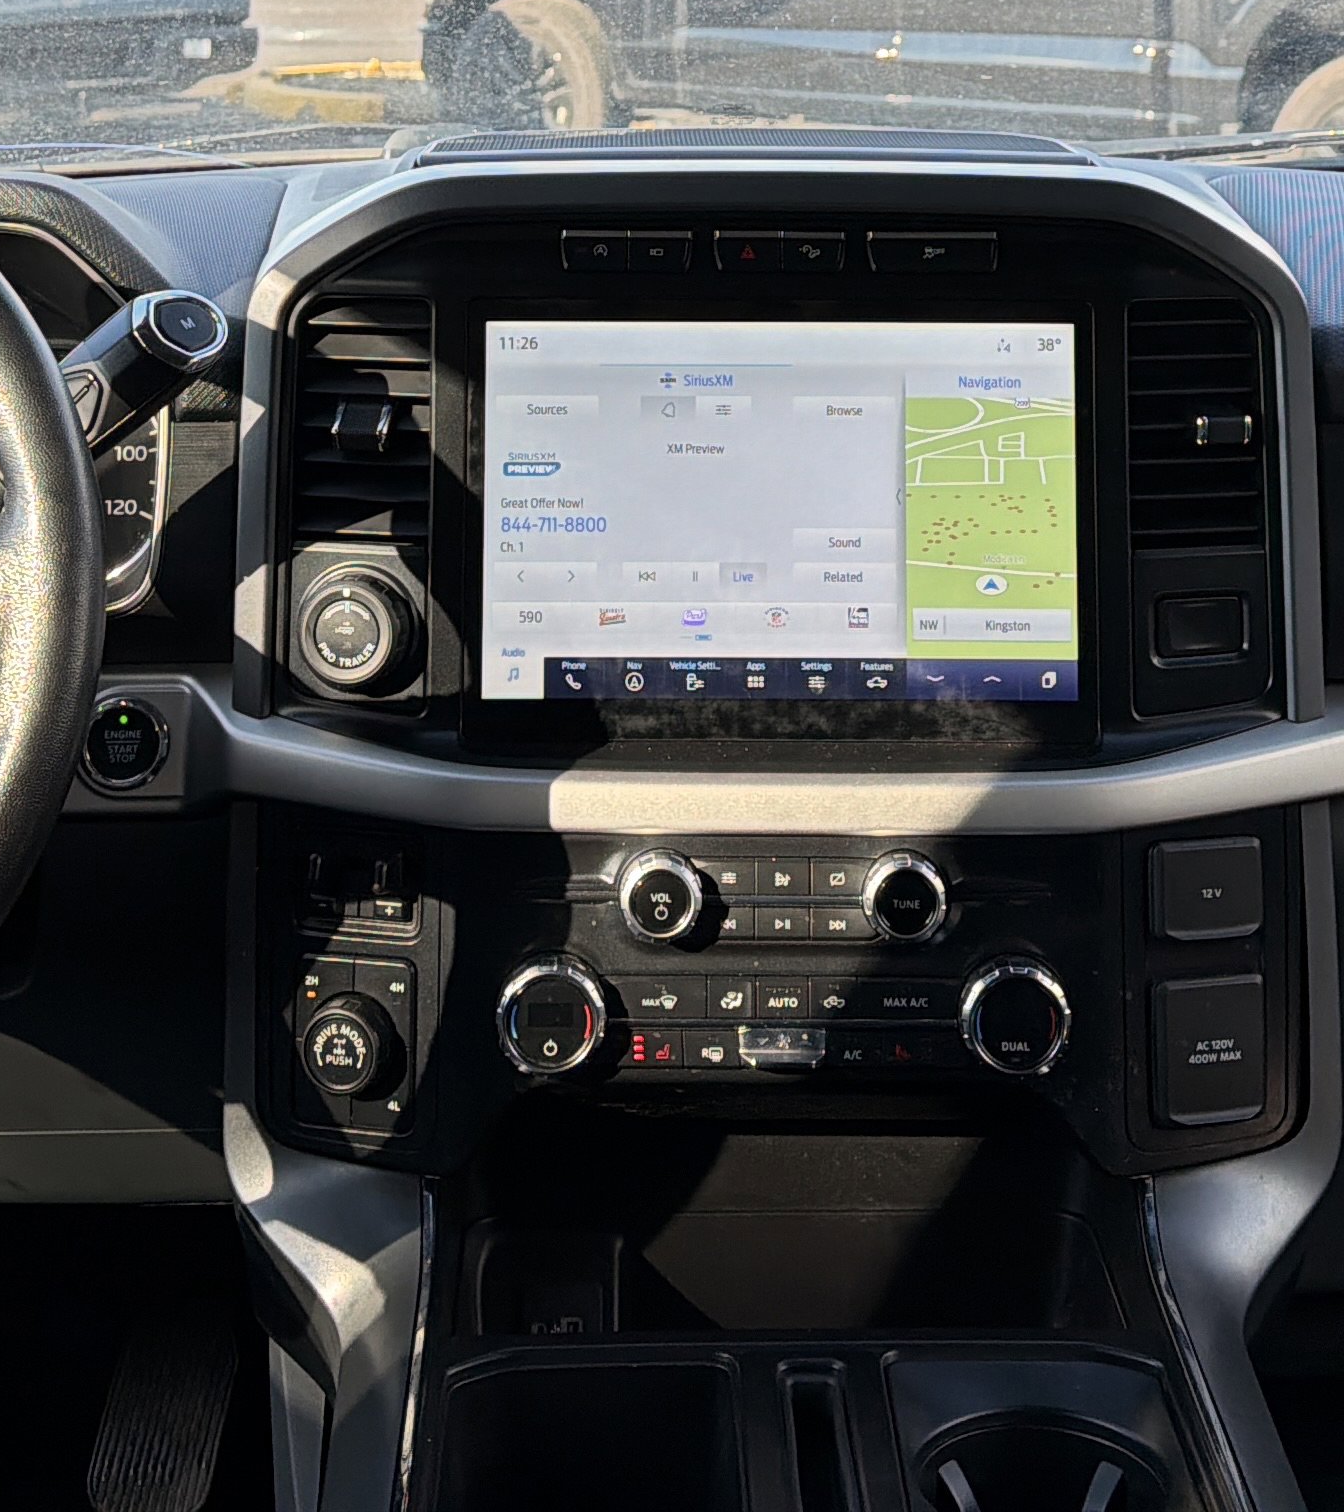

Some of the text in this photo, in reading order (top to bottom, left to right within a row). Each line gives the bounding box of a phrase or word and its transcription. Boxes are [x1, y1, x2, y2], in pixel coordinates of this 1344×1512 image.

[180, 316, 196, 331] M
[499, 336, 539, 350] 11:26
[1037, 337, 1062, 352] 38°
[683, 374, 734, 387] SiriusXM
[958, 376, 1022, 391] Navigation
[526, 403, 568, 416] Sources
[826, 405, 863, 417] Browse
[113, 445, 148, 463] 100
[666, 443, 725, 455] XM Preview
[105, 499, 138, 516] 120
[500, 497, 584, 509] Great Offer Now!
[500, 516, 607, 533] 844-711-8800
[500, 541, 516, 553] Ch.
[828, 536, 862, 548] Sound
[732, 570, 754, 583] Live
[823, 571, 863, 583] Related
[518, 611, 543, 624] 590
[919, 620, 939, 631] NW
[985, 620, 1031, 634] Kingston
[317, 641, 376, 668] PRO TRAILER
[501, 648, 526, 658] Audio
[561, 660, 587, 671] Phone
[626, 661, 643, 671] Nav
[669, 660, 696, 671] Vehicle
[746, 661, 766, 673] Apps
[800, 661, 833, 673] Settings
[860, 661, 894, 672] Features
[103, 729, 143, 740] ENGINE
[108, 744, 139, 754] START
[109, 754, 136, 764] STOP
[650, 892, 673, 905] VOL
[1201, 888, 1223, 899] 12 V
[892, 898, 921, 910] TUNE
[304, 975, 319, 986] 2H
[389, 982, 405, 994] 4H
[642, 998, 661, 1008] MAX
[768, 997, 799, 1009] AUTO
[883, 996, 929, 1008] MAX A/C
[313, 1022, 367, 1055] DRIVE MODE
[1001, 1041, 1031, 1053] DUAL
[1196, 1039, 1235, 1052] AC 120V
[325, 1054, 353, 1067] PUSH
[843, 1049, 863, 1061] A/C
[1188, 1050, 1243, 1065] 400W MAX
[387, 1100, 401, 1112] 4L
